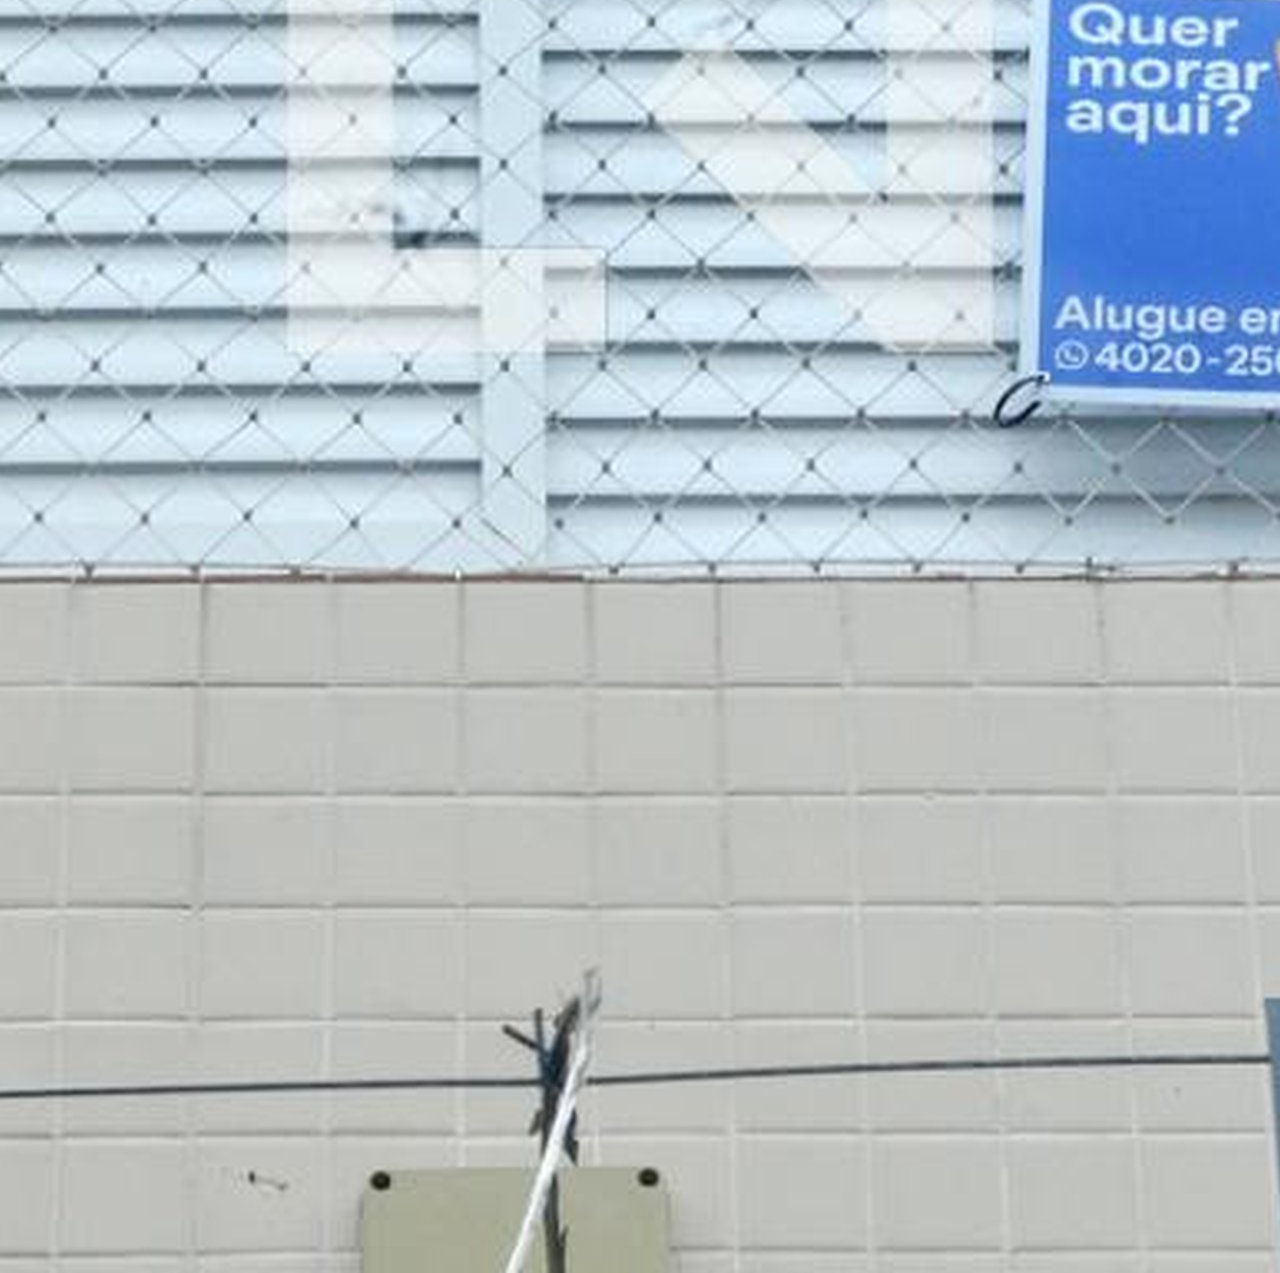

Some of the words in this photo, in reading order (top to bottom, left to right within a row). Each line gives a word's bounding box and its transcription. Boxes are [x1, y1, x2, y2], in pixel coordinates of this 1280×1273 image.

[1068, 3, 1238, 48] Quer
[1067, 56, 1271, 92] morar
[1066, 94, 1251, 144] aqui?
[1054, 295, 1227, 339] Alugue
